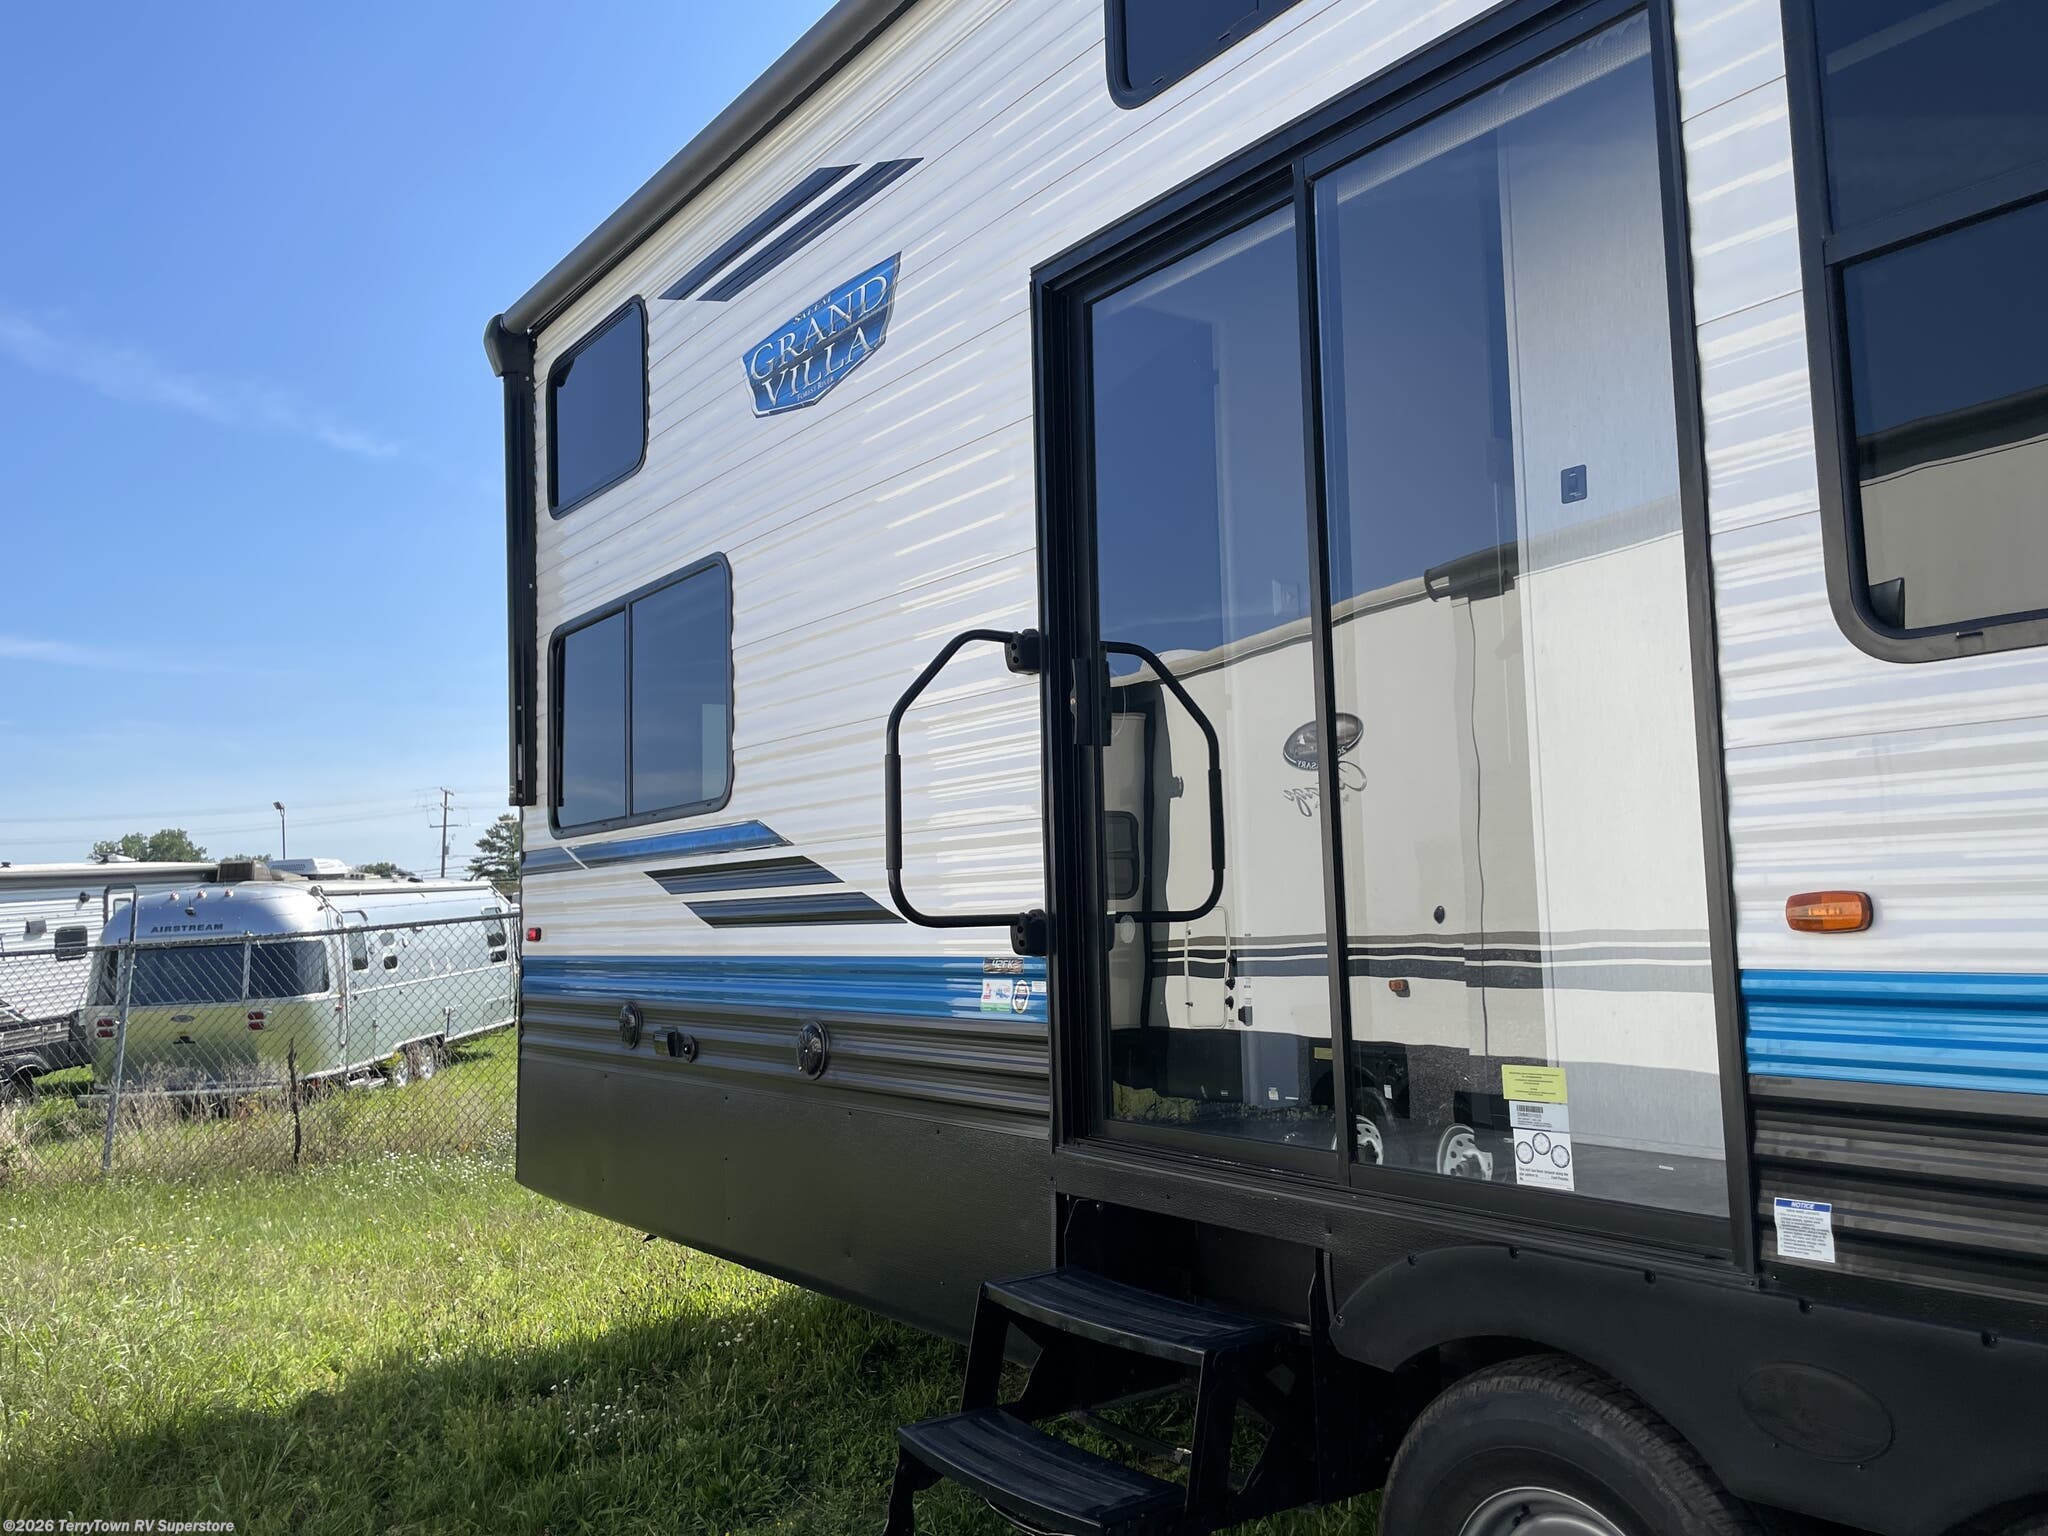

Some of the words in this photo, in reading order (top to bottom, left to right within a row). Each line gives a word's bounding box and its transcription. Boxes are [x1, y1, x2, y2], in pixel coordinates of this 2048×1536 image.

[751, 275, 888, 381] GRAND
[762, 327, 874, 407] VILLA
[150, 923, 224, 933] AIRSTREAM
[1790, 1201, 1815, 1210] NOTICE
